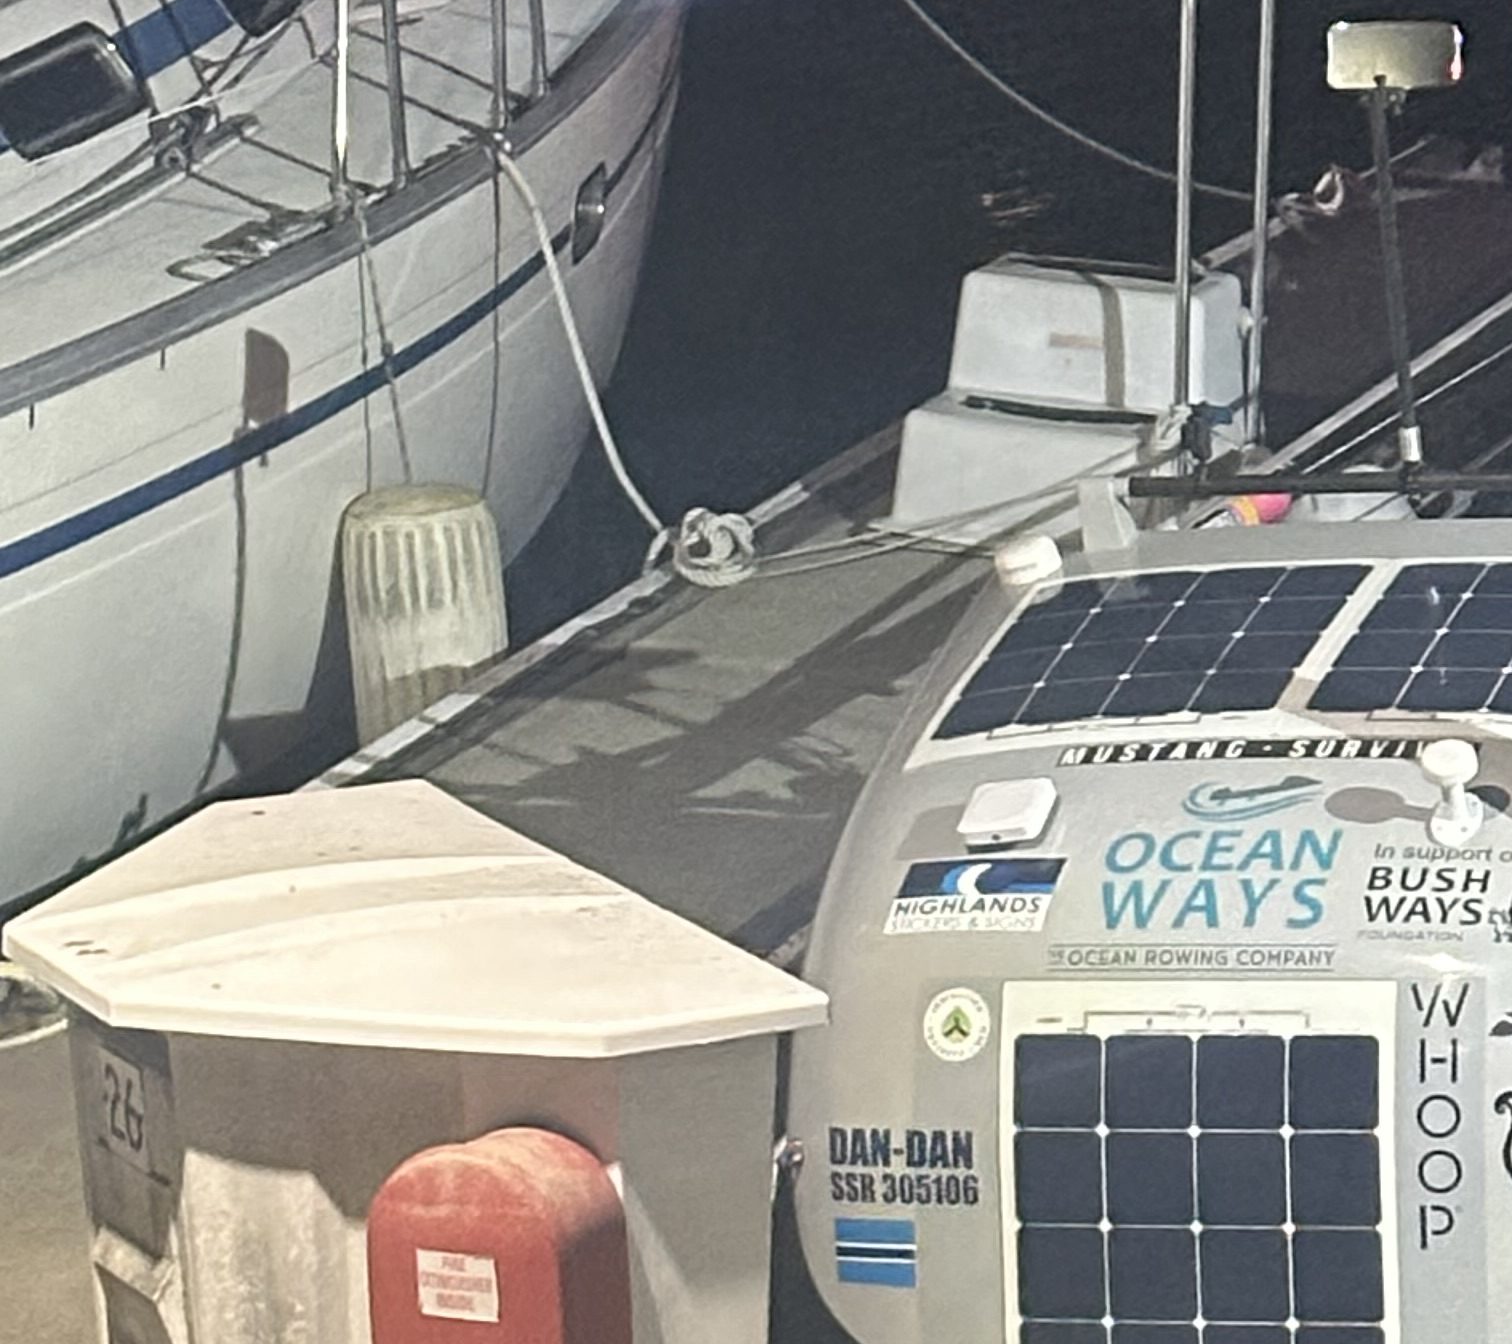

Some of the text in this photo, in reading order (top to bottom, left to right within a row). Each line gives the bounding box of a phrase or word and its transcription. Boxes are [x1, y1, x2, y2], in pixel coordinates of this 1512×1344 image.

[1060, 740, 1247, 765] MUSTANG
[1104, 828, 1344, 874] OCEAN
[1402, 846, 1493, 863] support
[1367, 866, 1492, 893] BUSH
[894, 897, 1043, 916] HIGHLANDS
[1102, 878, 1328, 930] WAYS
[1364, 895, 1483, 926] WAYS
[1067, 949, 1136, 967] OCEAN
[1144, 950, 1229, 966] ROWING
[1235, 949, 1336, 966] COMPANY
[1411, 982, 1470, 1250] WHOOP
[829, 1127, 973, 1169] DAN-DAN
[831, 1172, 979, 1205] SSR 305106
